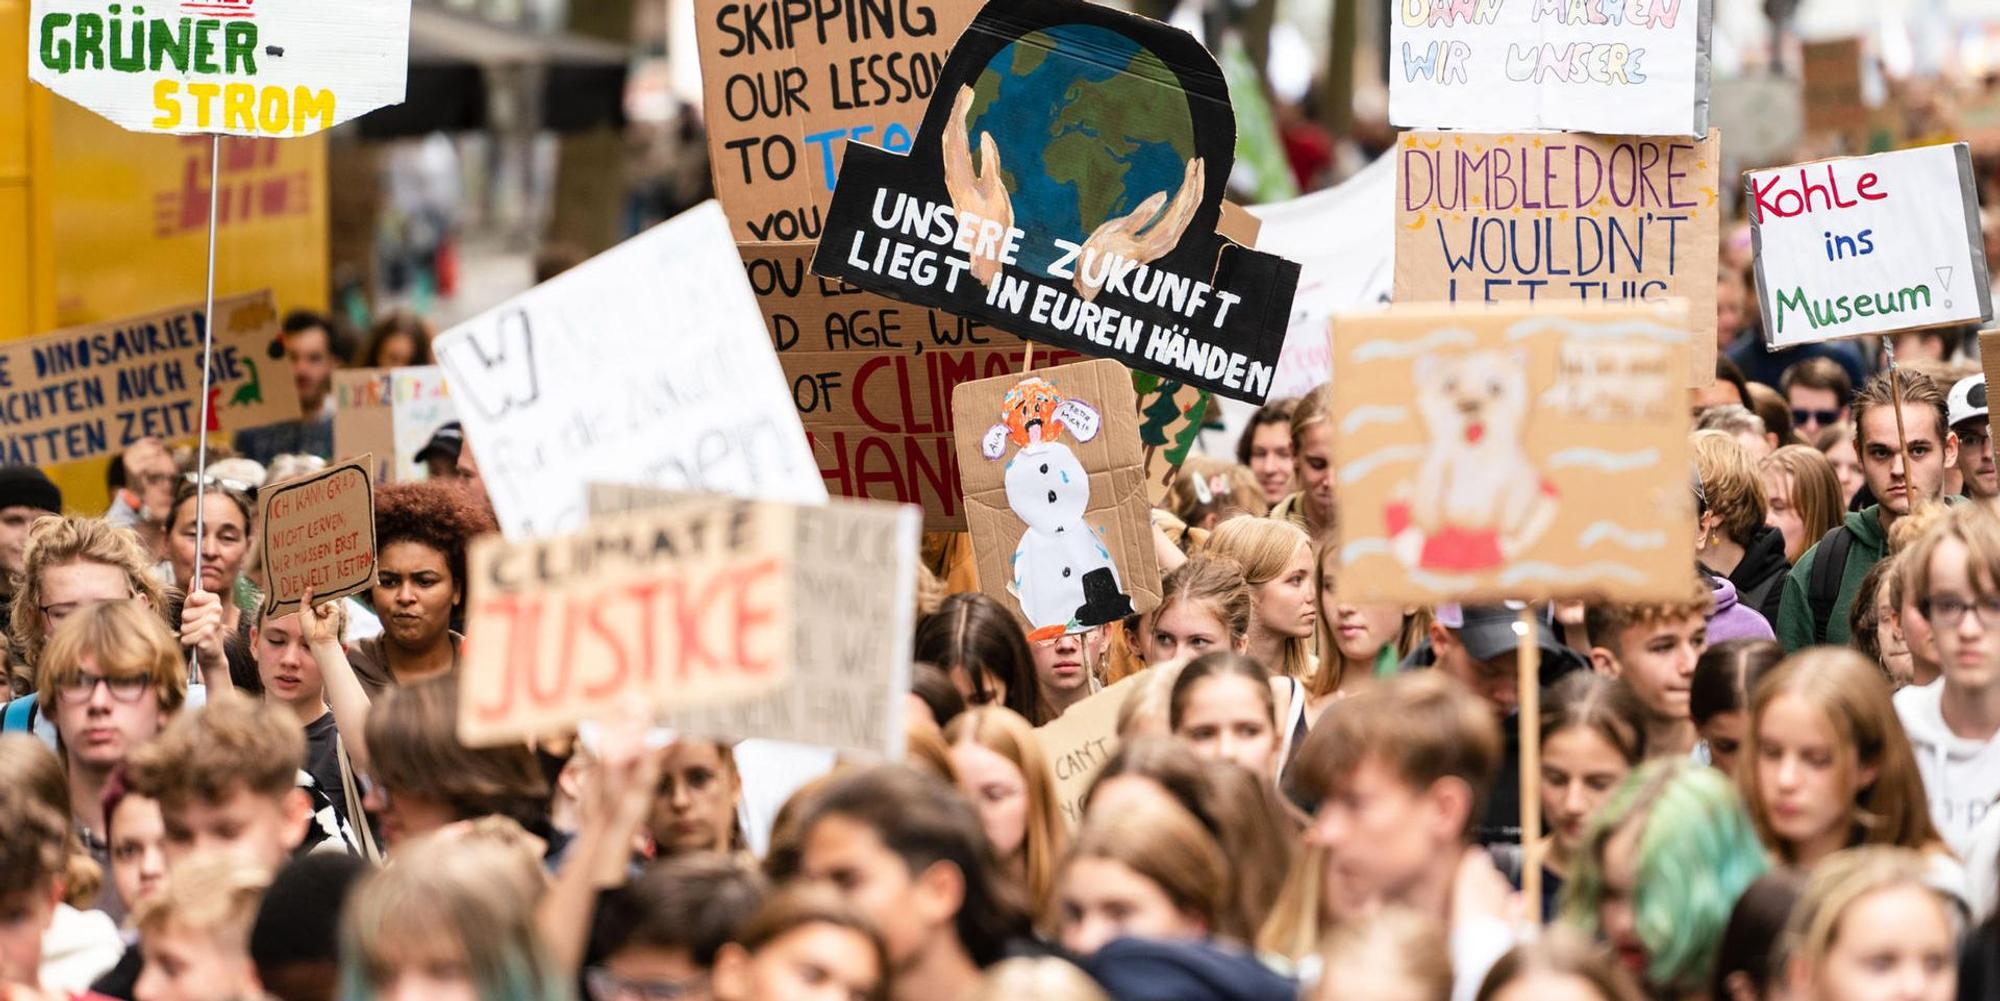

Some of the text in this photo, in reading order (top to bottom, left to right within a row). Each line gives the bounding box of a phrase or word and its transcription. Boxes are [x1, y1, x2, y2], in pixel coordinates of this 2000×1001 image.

[716, 0, 937, 57] SKIPPING
[1402, 41, 1648, 85] WIR UNSERE
[152, 79, 336, 137] STROM
[725, 66, 811, 121] OUR
[725, 134, 796, 184] TO
[1404, 142, 1699, 213] DUMBLEDORE
[1752, 163, 1888, 225] Kohle
[872, 187, 1242, 329] UNSERE ZUKUNFT
[1436, 211, 1689, 277] WOULDN'T
[1823, 228, 1875, 262] ins
[847, 230, 971, 294] LIEGT
[986, 271, 1030, 316] IN
[1029, 284, 1144, 355] EUREN
[1143, 323, 1273, 398] HÄNDEN
[32, 310, 216, 380] DINOSAURIER
[117, 359, 187, 402] AUCH
[194, 345, 243, 386] SIE
[793, 371, 842, 413] OF
[116, 400, 193, 446] ZEIT
[268, 495, 290, 520] ICH
[271, 525, 305, 550] NICHT
[334, 529, 359, 555] ERST
[489, 500, 762, 588] CLIMATE
[280, 547, 373, 598] DIE WELT RETTEN
[1054, 736, 1112, 781] CAN'T
